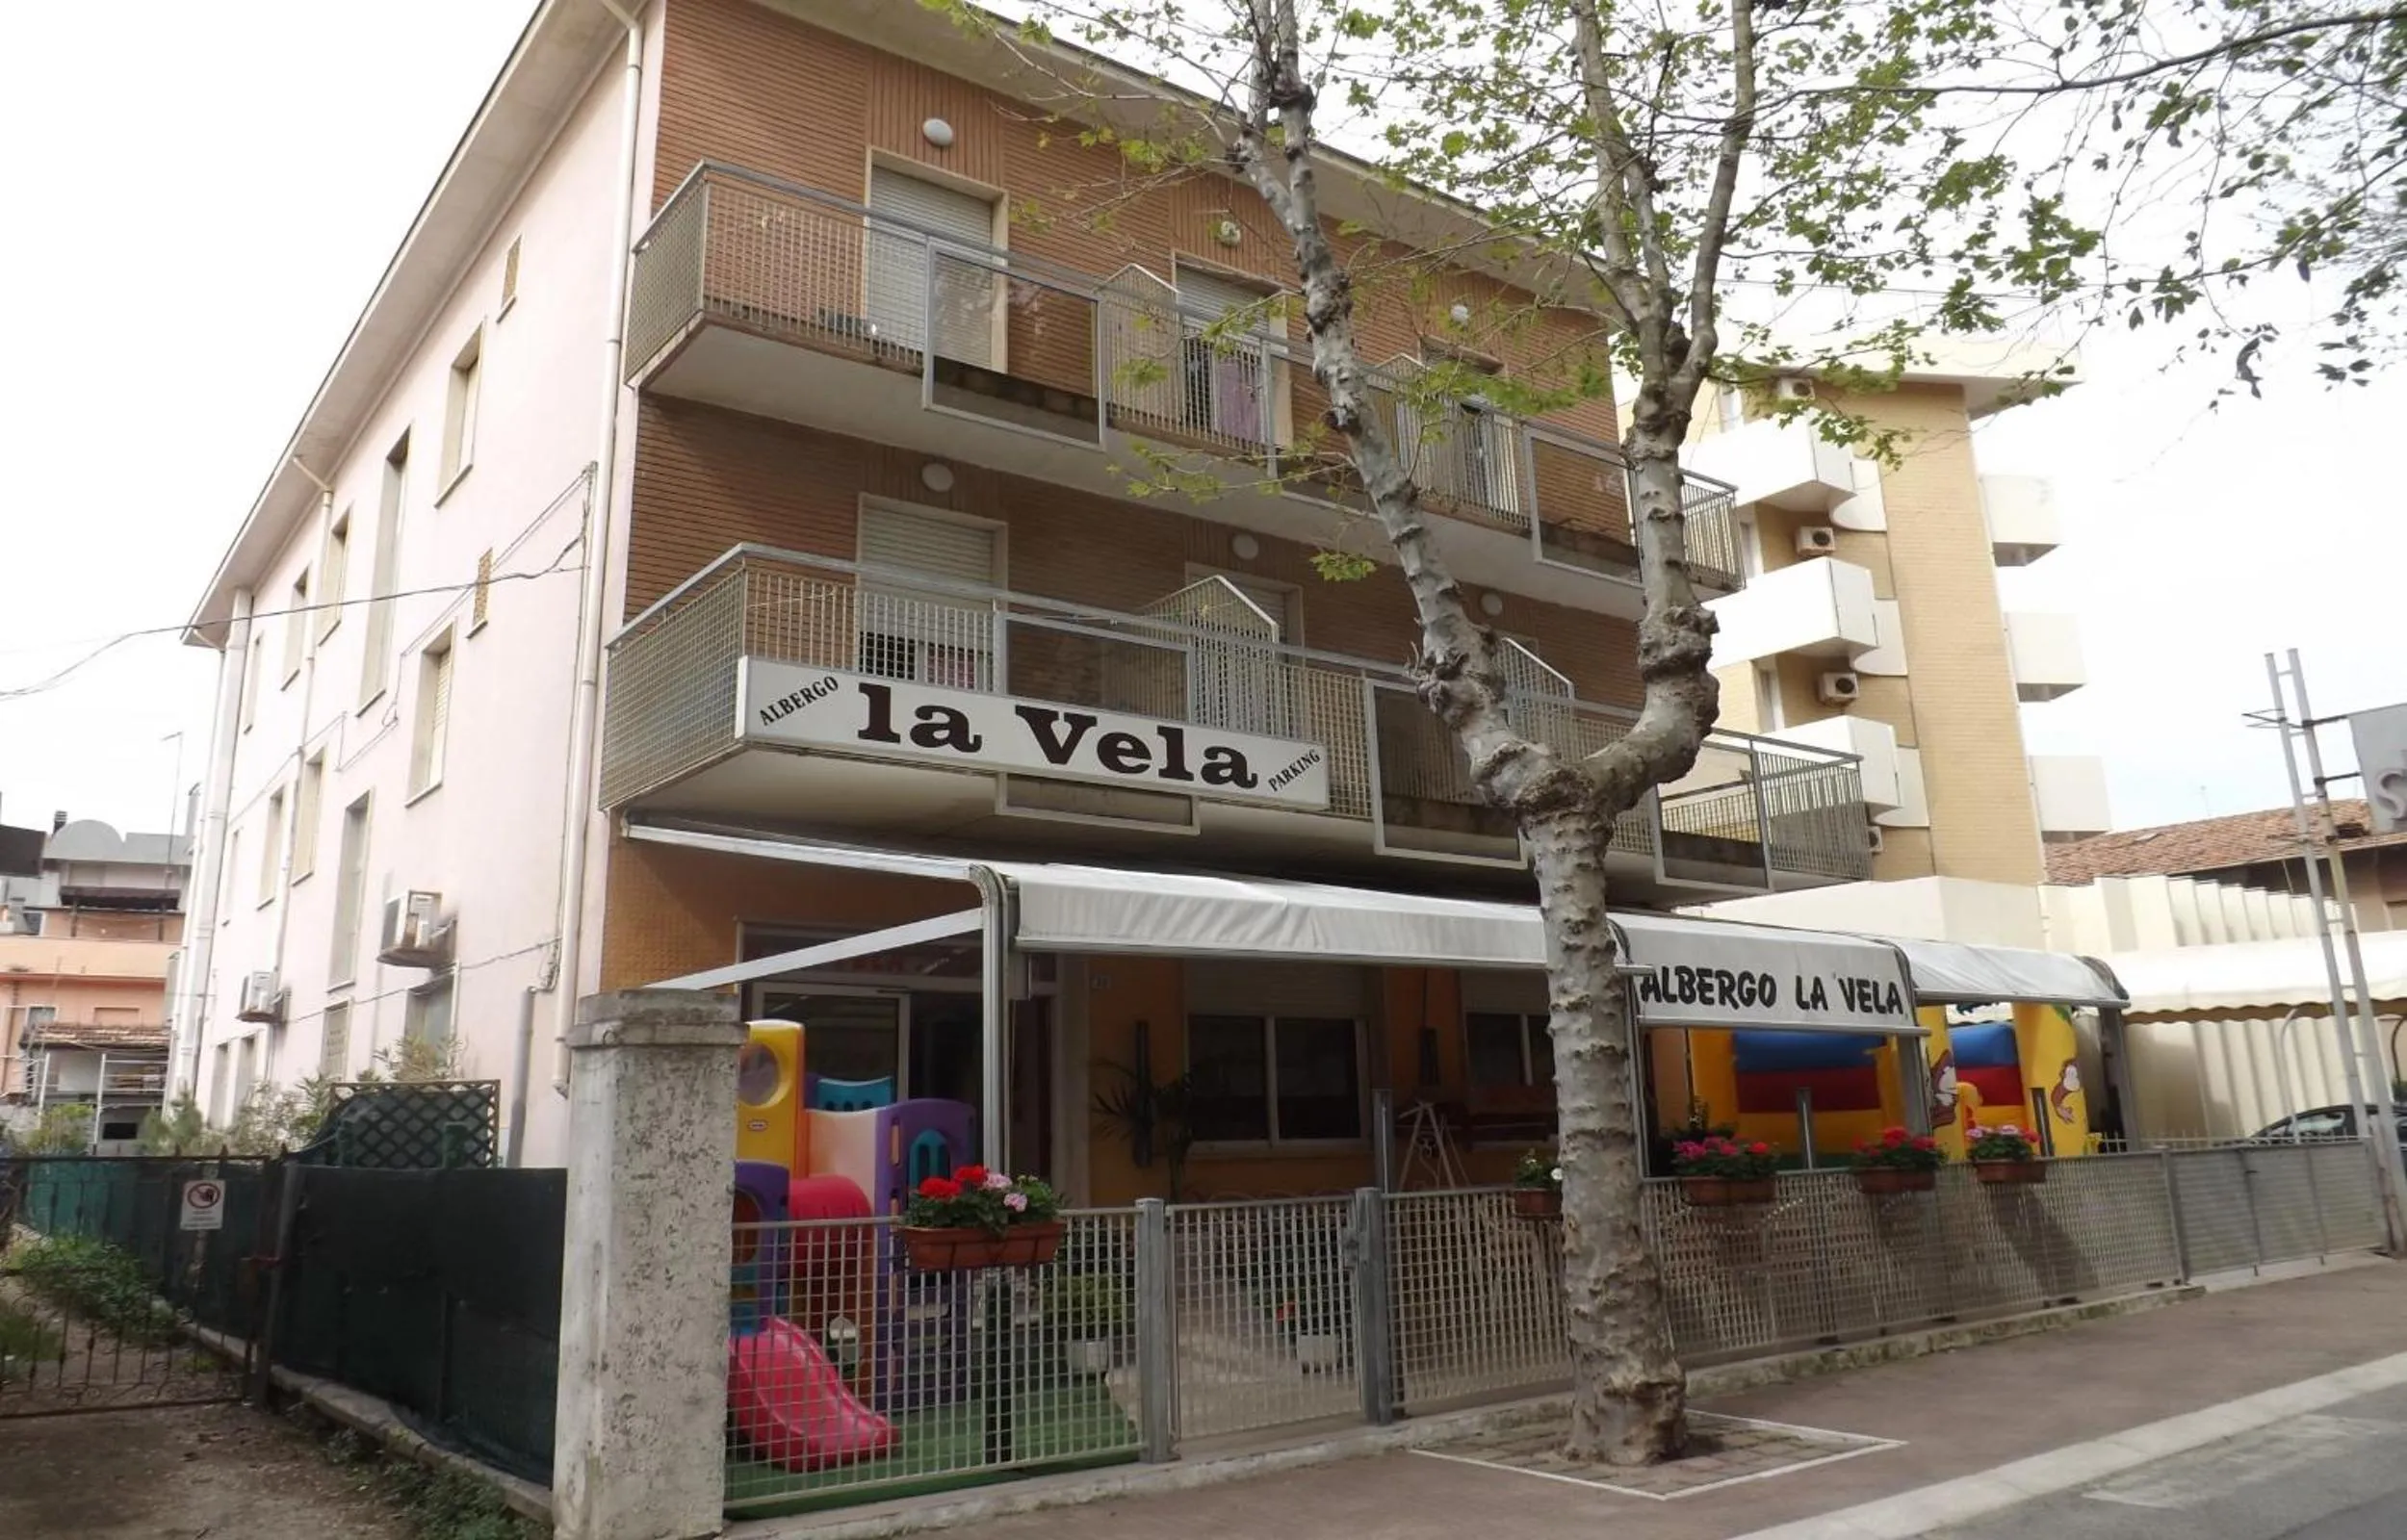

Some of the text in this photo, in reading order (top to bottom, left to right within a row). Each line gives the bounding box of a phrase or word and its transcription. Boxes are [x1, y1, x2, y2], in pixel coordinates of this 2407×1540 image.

[760, 676, 839, 726] ALBERGO
[858, 682, 1257, 788] la Vela
[1268, 749, 1320, 791] PARKING
[1640, 965, 1903, 1014] ALBERGO LA VELA
